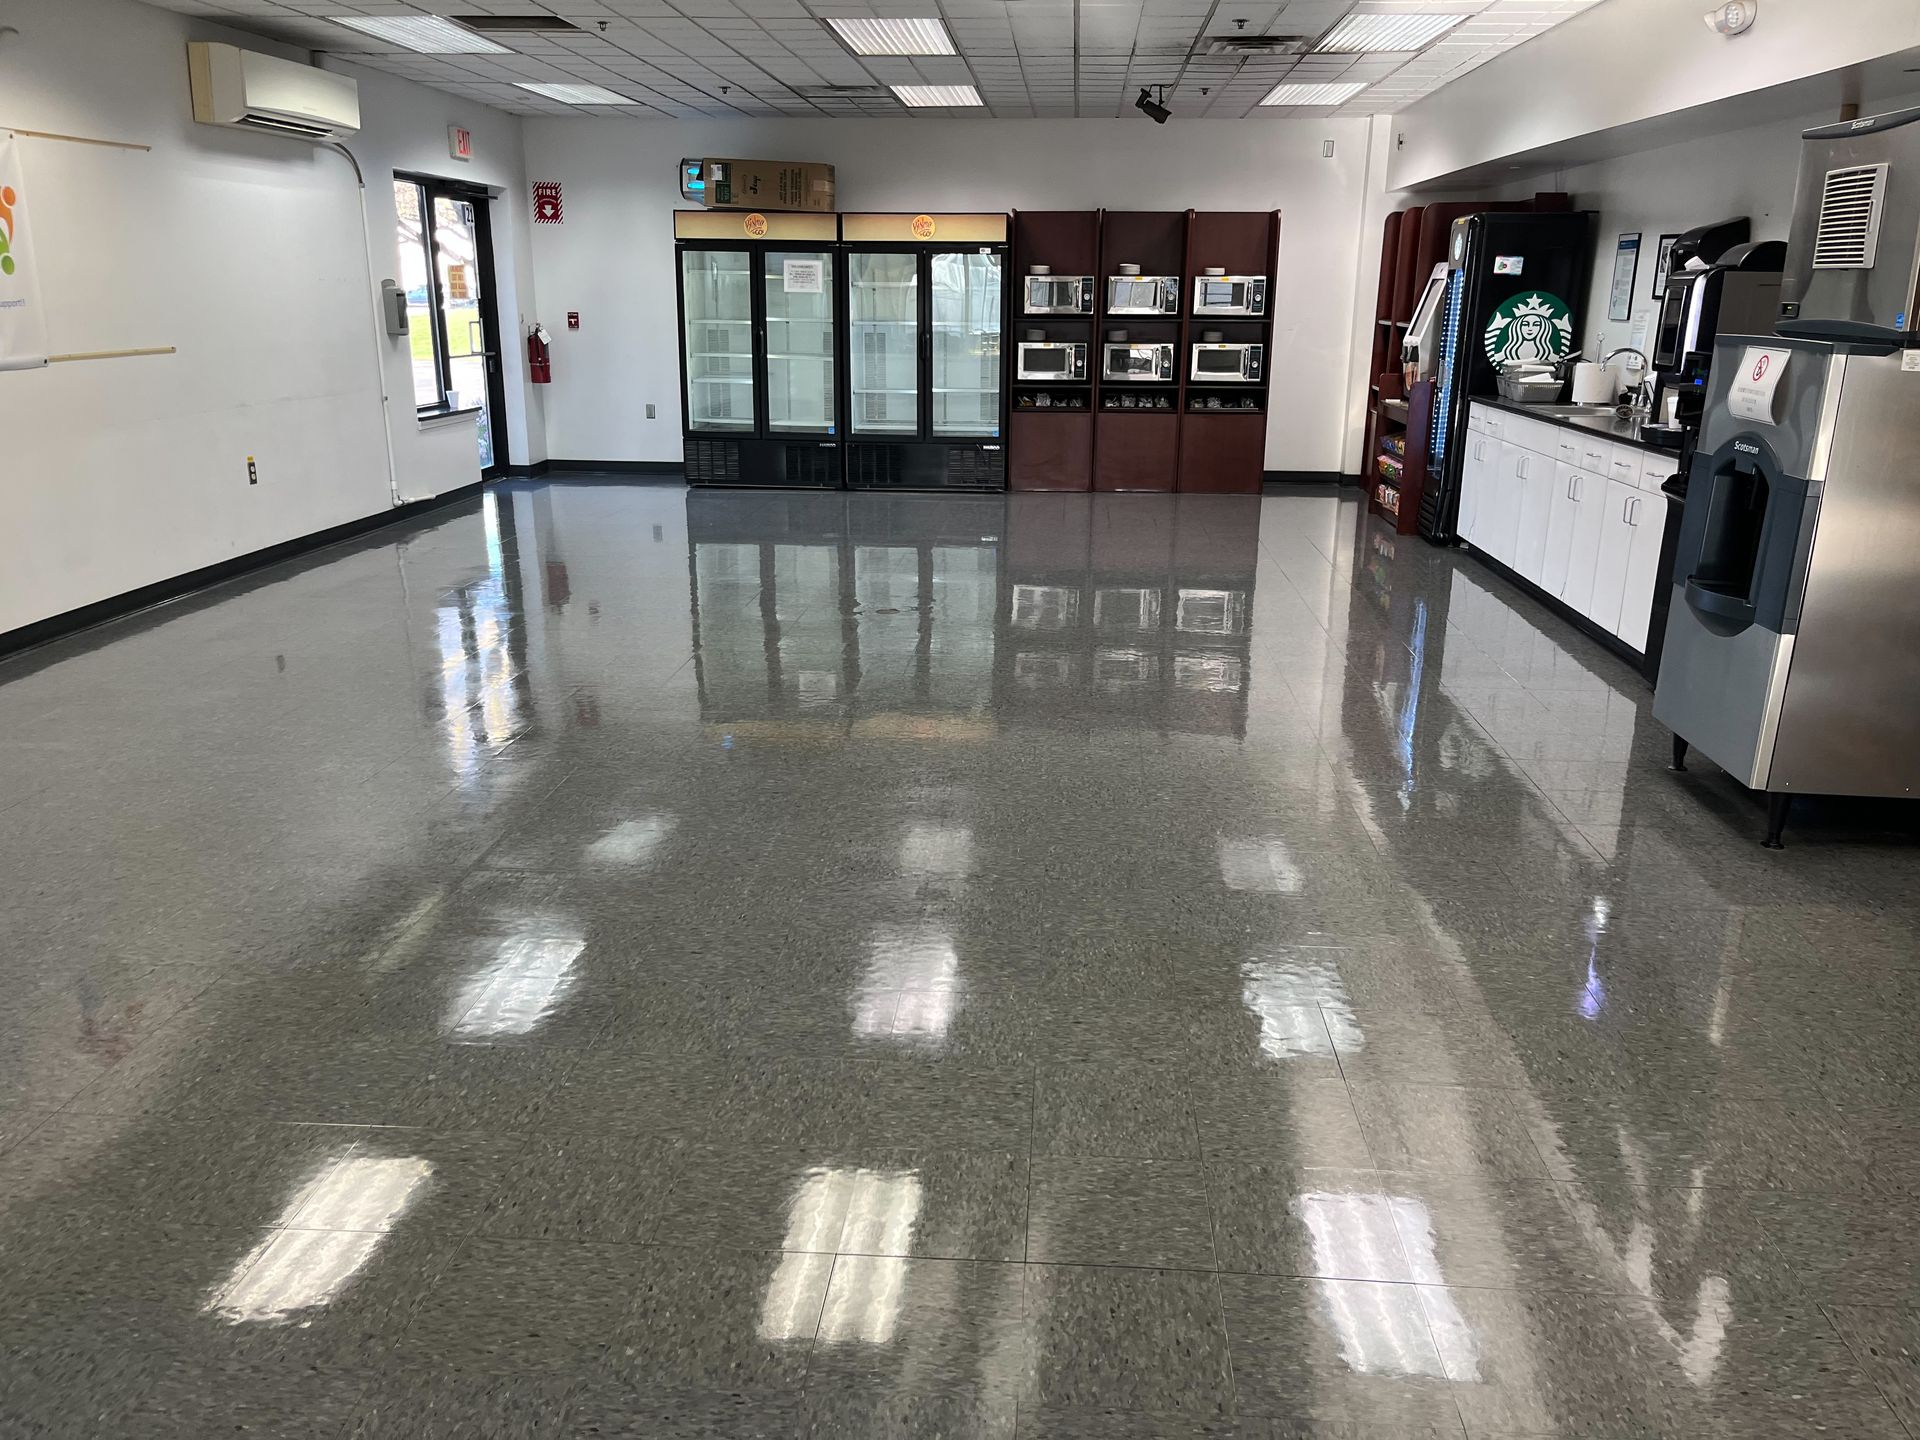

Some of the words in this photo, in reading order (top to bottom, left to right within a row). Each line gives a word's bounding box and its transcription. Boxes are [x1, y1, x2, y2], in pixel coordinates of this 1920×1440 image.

[457, 129, 471, 155] EXIT
[538, 188, 556, 196] FIRE
[1734, 441, 1759, 454] Scotsman
